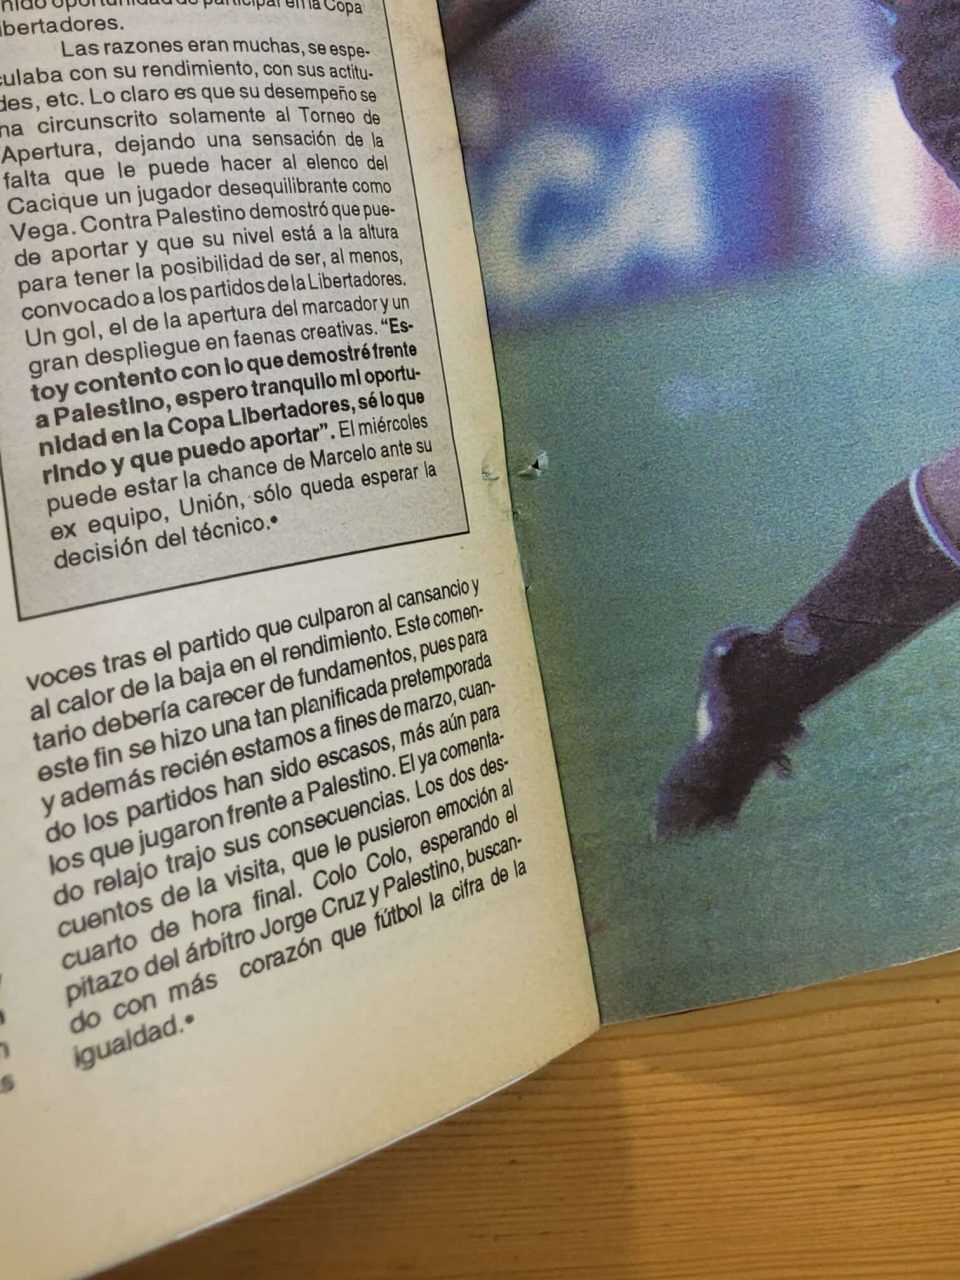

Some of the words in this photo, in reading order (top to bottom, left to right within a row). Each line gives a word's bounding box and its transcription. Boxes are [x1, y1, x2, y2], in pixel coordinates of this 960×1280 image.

[60, 40, 99, 57] Las
[103, 40, 183, 55] razones
[187, 39, 228, 52] eran
[232, 36, 305, 56] muchas,
[307, 42, 326, 55] se
[329, 44, 370, 61] espe-
[0, 141, 101, 165] Apertura,
[114, 131, 195, 156] dejando
[206, 133, 242, 147] una
[251, 129, 336, 146] sensación
[345, 130, 363, 147] de
[370, 131, 384, 148] la
[7, 192, 98, 214] Cacique
[105, 190, 131, 205] un
[136, 180, 211, 207] jugador
[217, 176, 347, 198] desequilibrante
[351, 180, 391, 193] como
[35, 413, 49, 428] a
[53, 395, 171, 426] Palestino,
[175, 384, 248, 408] espero
[250, 371, 337, 396] tranquilo
[339, 367, 361, 386] mi
[363, 364, 420, 387] oportu-
[50, 522, 77, 540] ex
[87, 506, 169, 533] equipo,
[178, 491, 245, 516] Unión,
[253, 482, 292, 504] sólo
[300, 472, 355, 498] queda
[360, 465, 418, 488] esperar
[423, 460, 437, 477] la
[25, 661, 96, 690] voces
[102, 650, 147, 673] tras
[152, 640, 172, 661] el
[178, 625, 250, 662] partido
[255, 618, 292, 643] que
[297, 600, 374, 630] culparon
[378, 592, 392, 612] al
[396, 578, 469, 608] cansancio
[470, 578, 478, 597] y
[37, 755, 89, 781] este
[93, 746, 122, 768] fin
[128, 739, 156, 758] se
[160, 726, 207, 751] hizo
[211, 715, 252, 737] una
[253, 705, 287, 727] tan
[290, 678, 388, 723] planificada
[390, 653, 492, 697] pretemporada
[61, 934, 137, 969] cuarto
[150, 919, 179, 942] de
[191, 901, 242, 930] hora
[252, 879, 302, 911] final.
[312, 862, 357, 890] Colo
[366, 845, 412, 872] Colo,
[419, 813, 499, 854] esperando
[505, 803, 518, 824] el
[70, 1010, 101, 1033] do
[113, 993, 156, 1019] con
[168, 973, 217, 1002] más
[239, 936, 322, 978] corazón
[330, 921, 366, 949] que
[373, 895, 422, 931] fútbol
[428, 891, 445, 910] la
[451, 877, 485, 901] cifra
[490, 866, 508, 886] de
[512, 858, 527, 877] la
